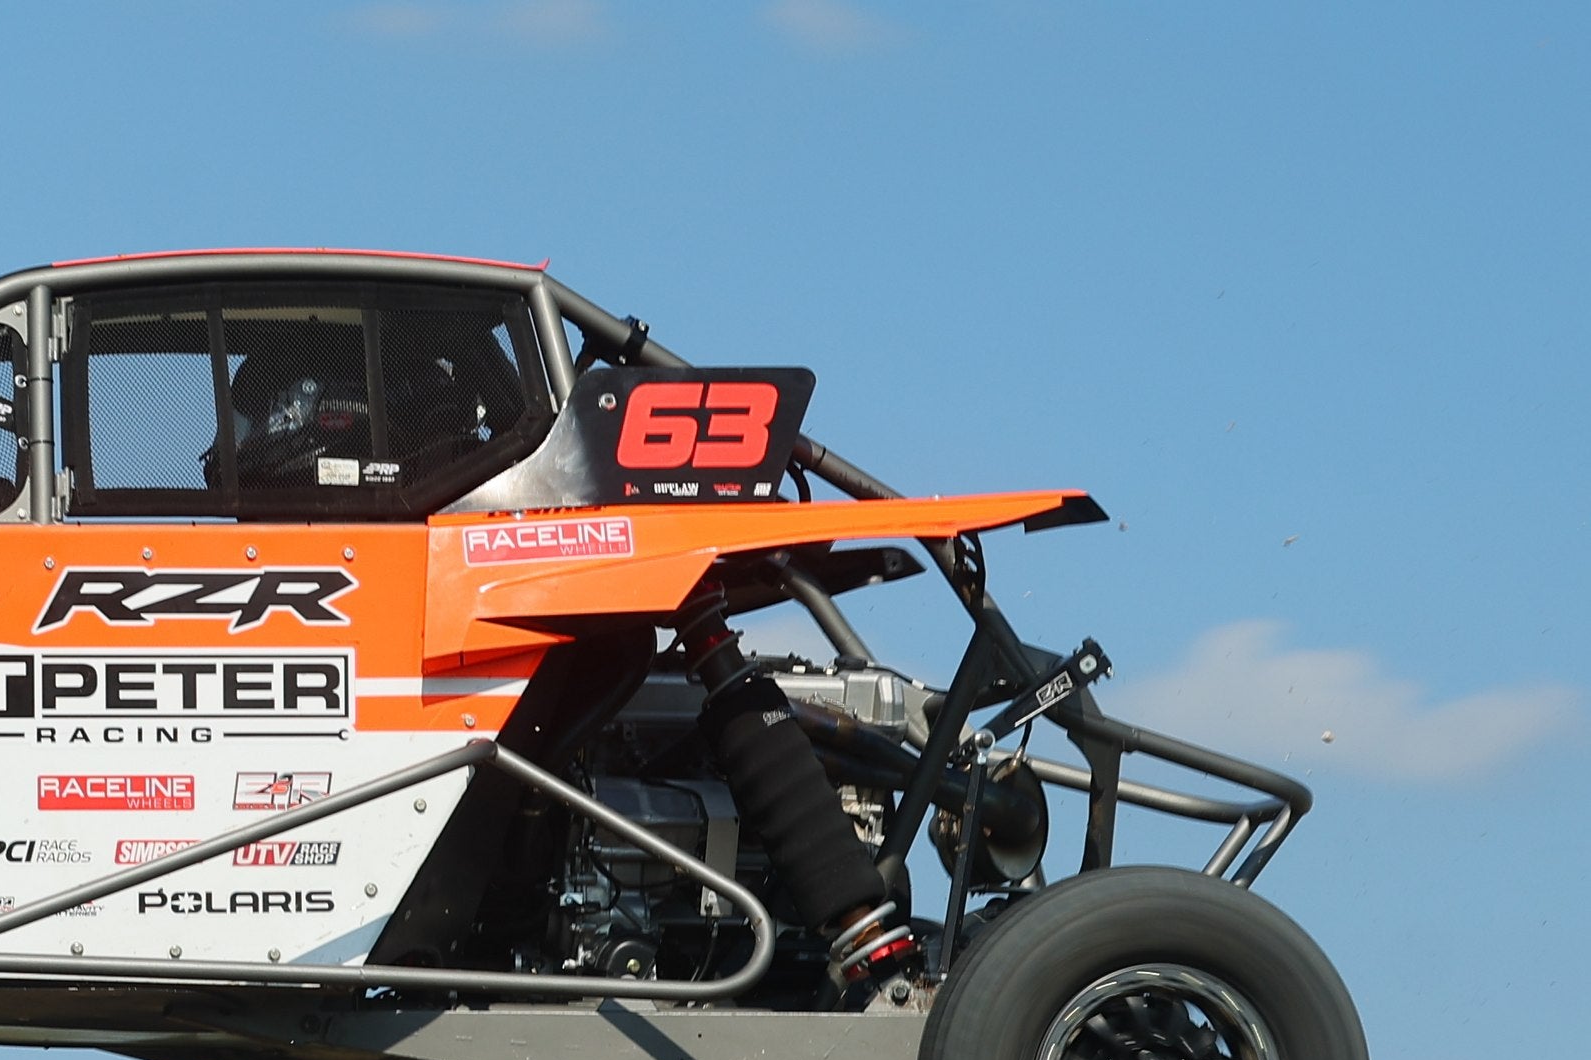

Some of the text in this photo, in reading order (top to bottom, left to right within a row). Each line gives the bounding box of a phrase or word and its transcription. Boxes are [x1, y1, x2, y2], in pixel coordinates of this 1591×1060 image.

[617, 383, 778, 468] 63
[468, 523, 627, 552] RACELINE
[37, 571, 353, 629] RZR
[36, 728, 212, 743] RACING
[40, 778, 192, 798] RACELINE
[127, 798, 192, 809] WHEELS
[39, 840, 78, 851] RACE
[119, 841, 198, 863] SIMPS
[237, 843, 294, 865] UTV
[300, 842, 338, 855] RACE
[36, 851, 92, 863] RADIOS
[294, 854, 333, 864] SHOP
[139, 891, 334, 914] POLARIS
